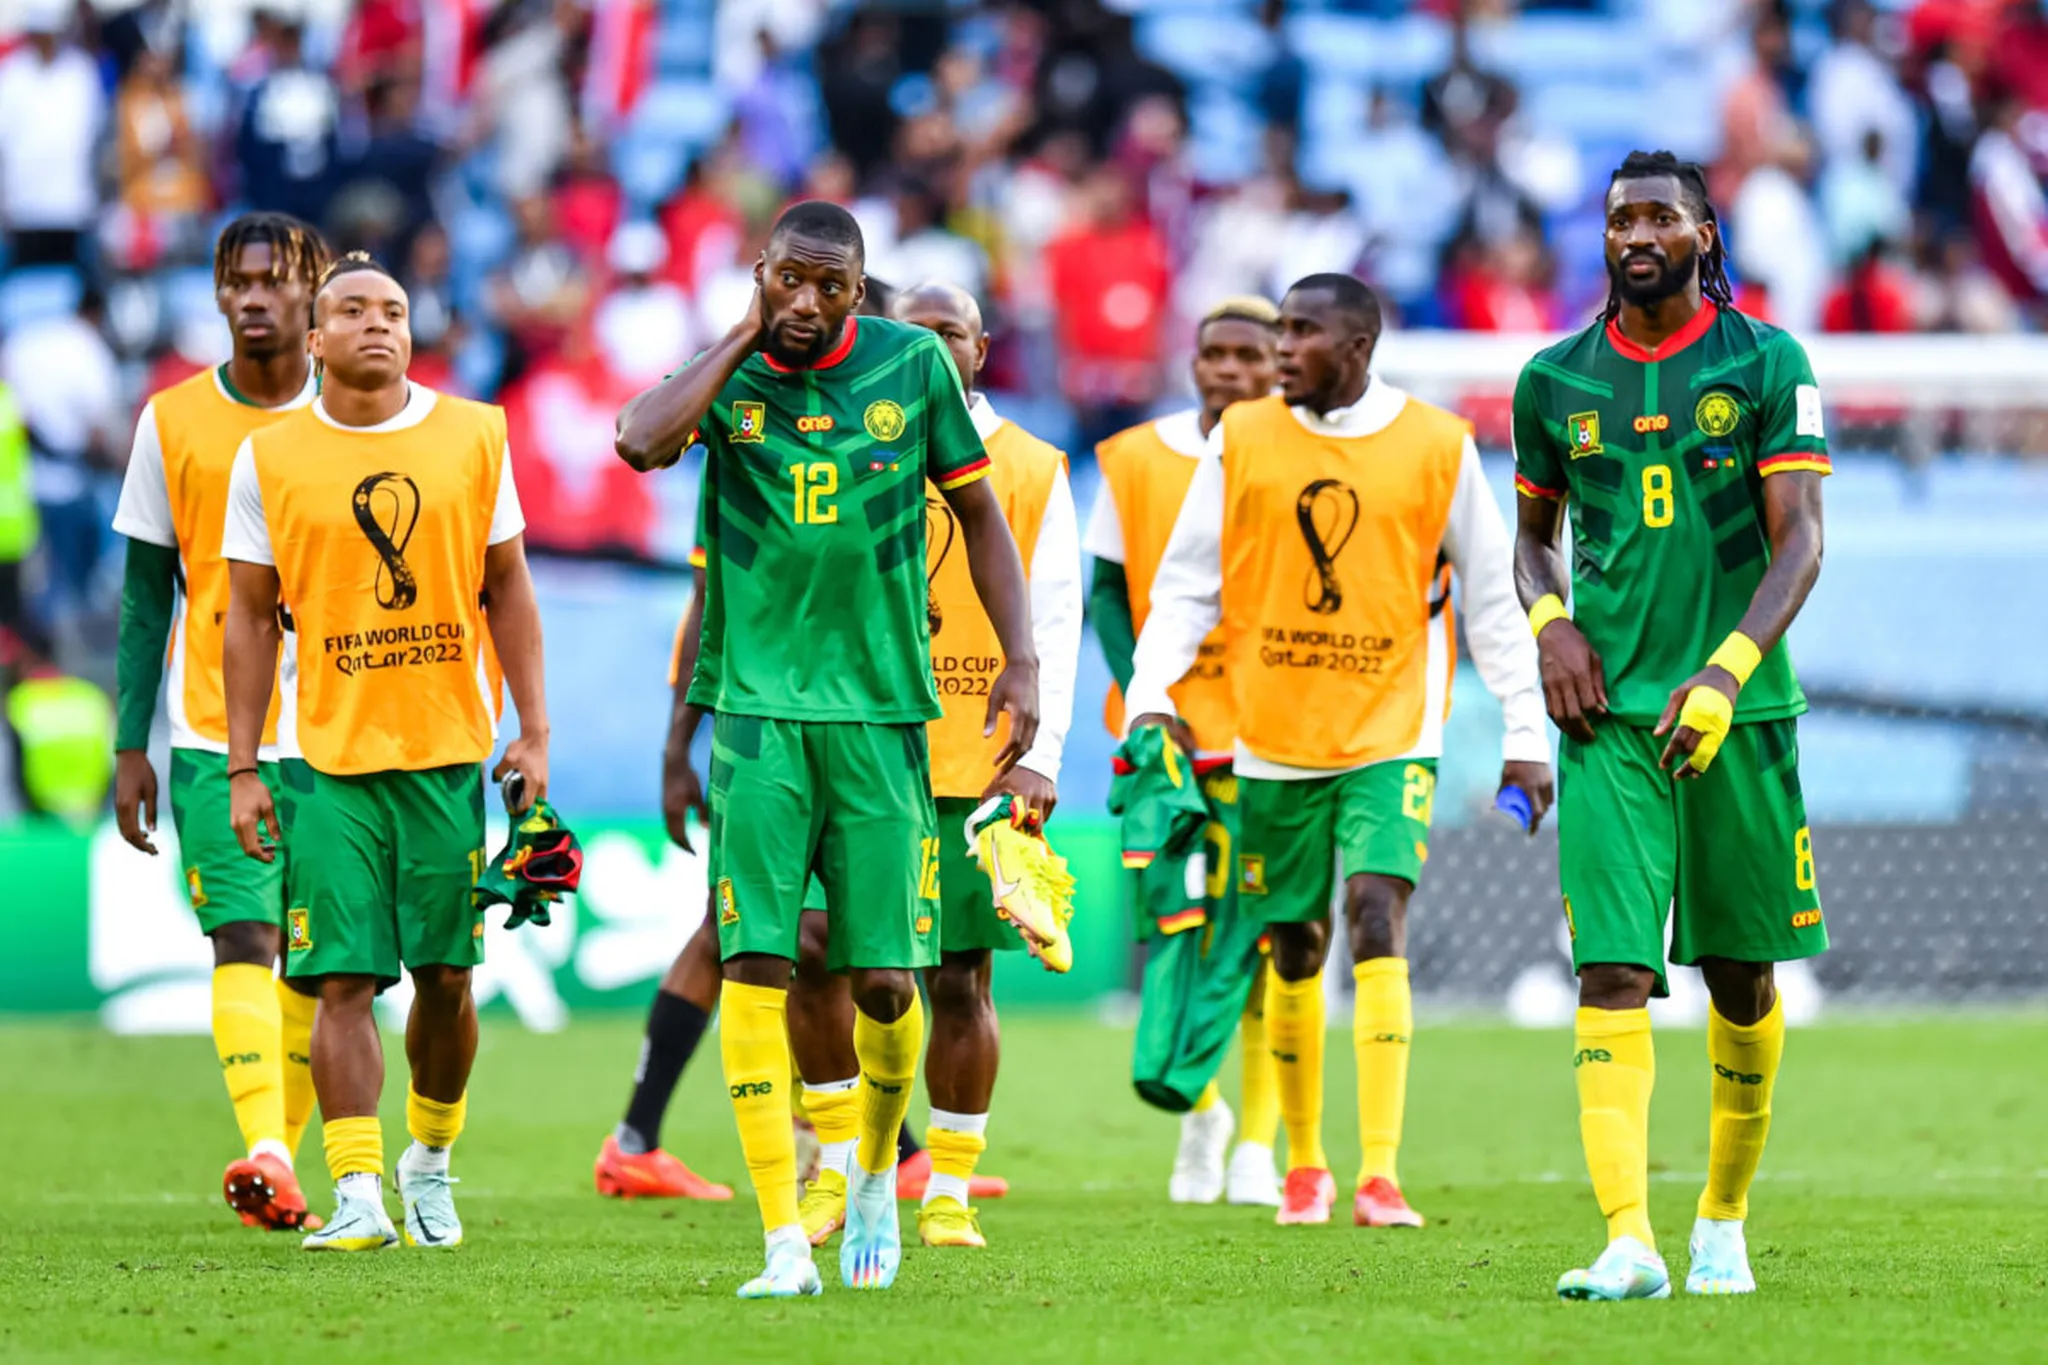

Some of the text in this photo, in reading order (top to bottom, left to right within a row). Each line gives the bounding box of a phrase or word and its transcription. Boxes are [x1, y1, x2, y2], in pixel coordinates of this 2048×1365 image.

[797, 415, 835, 432] one
[1632, 414, 1670, 433] one
[789, 461, 838, 524] 12
[1642, 464, 1674, 528] 8
[324, 634, 362, 653] FIFA
[365, 625, 432, 646] WORLD
[1290, 630, 1356, 650] WORLD
[1360, 635, 1393, 651] CUP
[962, 656, 999, 672] CUP
[1795, 826, 1816, 890] 8
[1715, 1063, 1764, 1086] one
[730, 1081, 773, 1099] one
